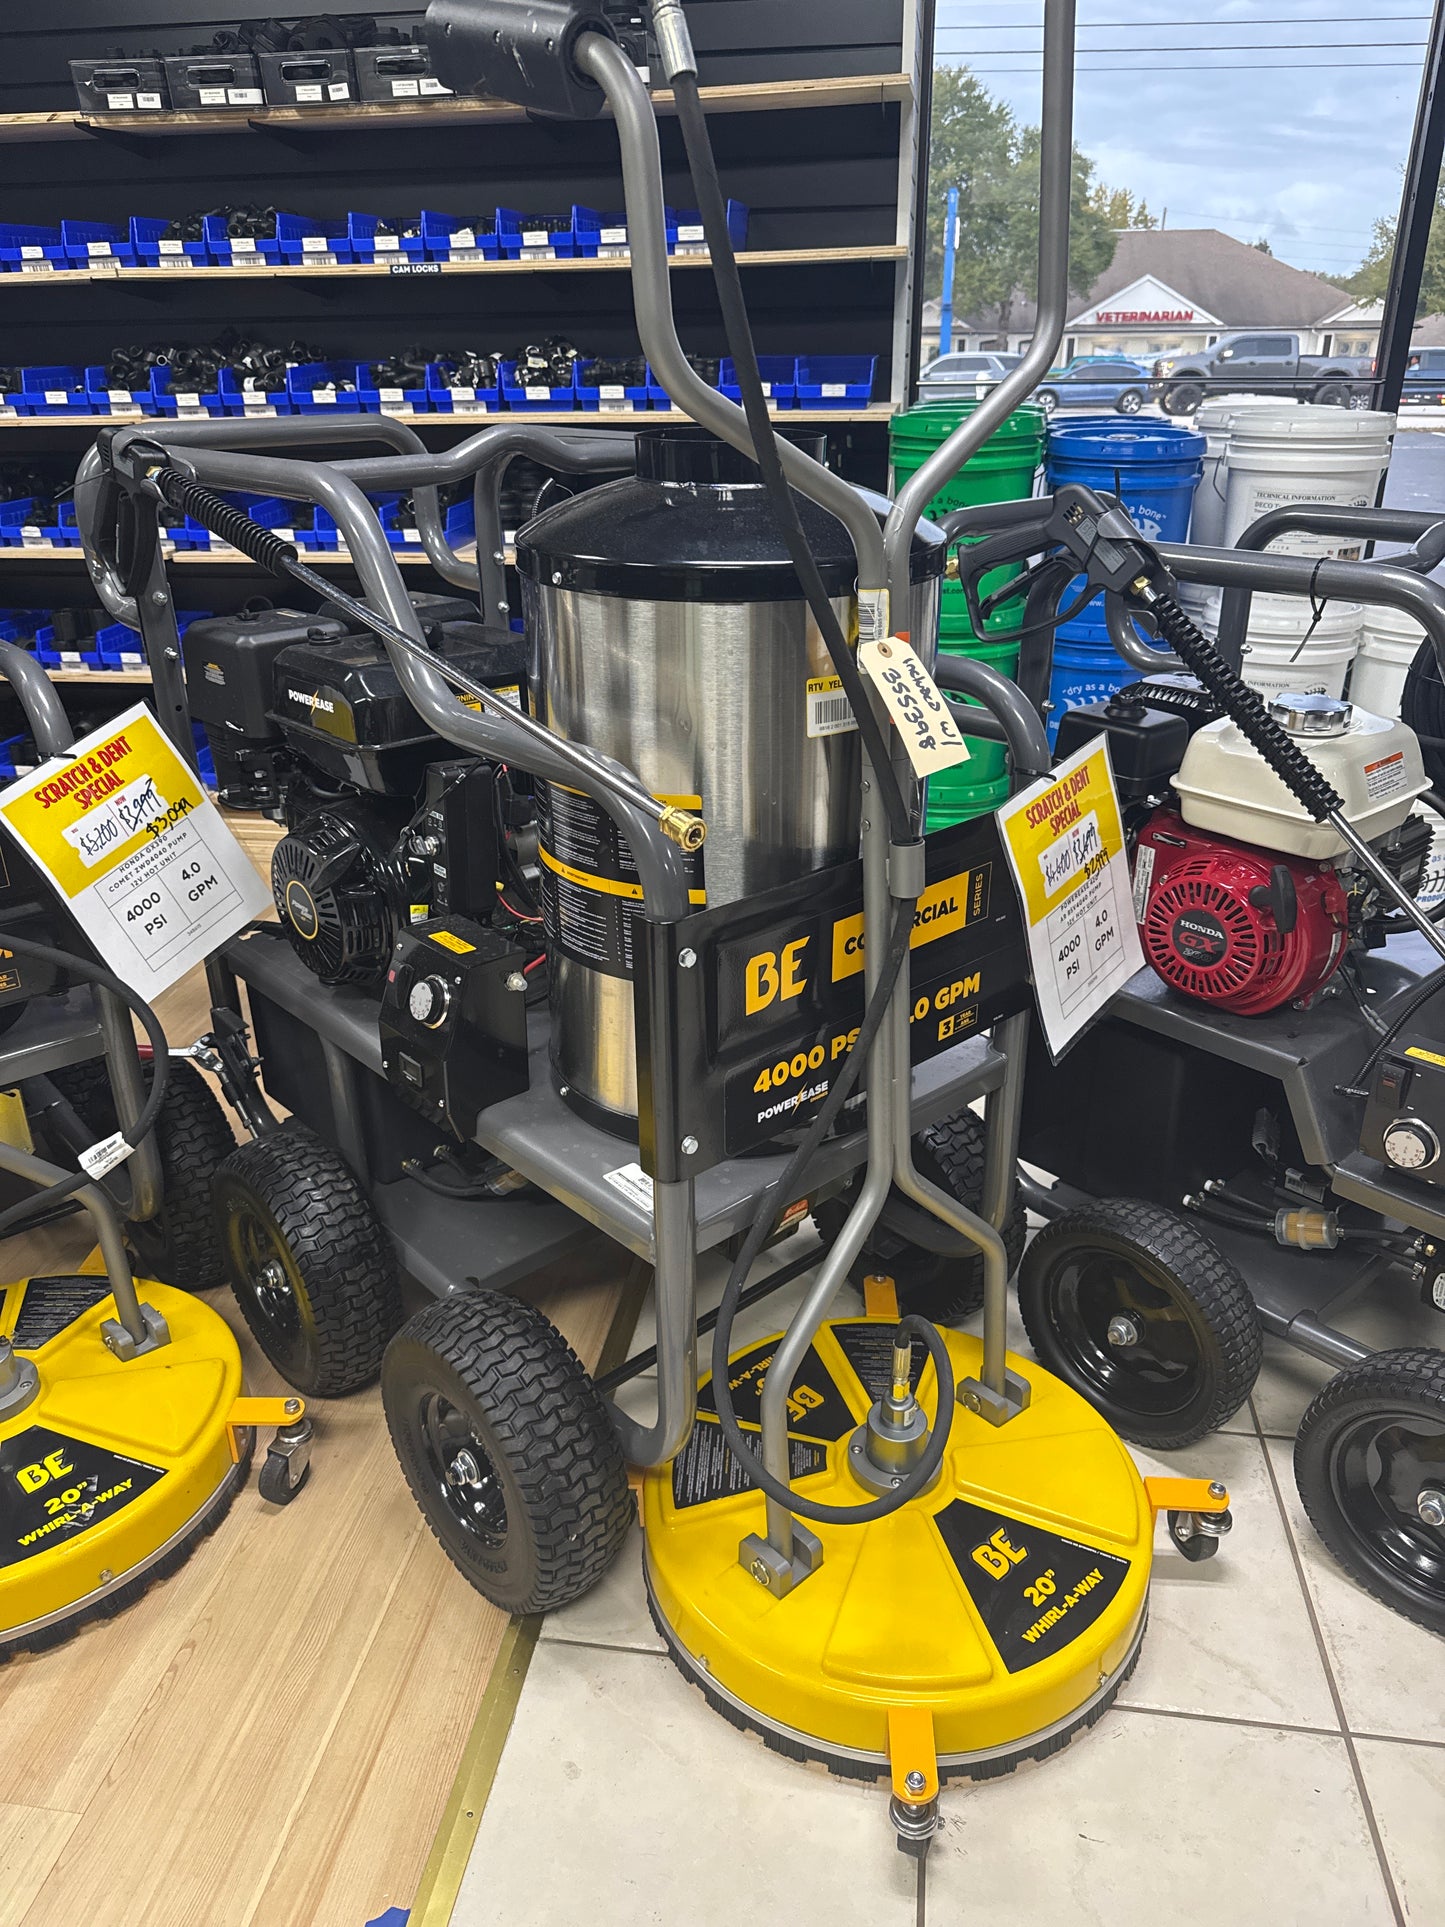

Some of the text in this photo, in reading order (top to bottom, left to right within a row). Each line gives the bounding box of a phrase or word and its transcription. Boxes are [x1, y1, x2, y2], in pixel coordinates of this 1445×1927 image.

[391, 264, 439, 274] CAM LOCKS
[1096, 310, 1194, 323] VETERINARIAN
[1256, 491, 1336, 502] TECHNICAL INFORMATION
[808, 682, 824, 692] RTV
[34, 735, 133, 809] SCRATCH & DENT
[73, 769, 125, 810] SPECIAL
[1025, 765, 1091, 829] SCRATCH & DENT
[145, 797, 194, 839] $3,099
[1049, 799, 1082, 837] SPECIAL
[108, 832, 188, 893] COMET ZWD4040 PUMP
[119, 835, 168, 873] HONDA GX390
[130, 851, 178, 888] 12V HOT UNIT
[181, 861, 201, 881] 4.0
[188, 874, 219, 902] GPM
[972, 872, 985, 917] SERIES
[1088, 881, 1102, 898] PUMP
[126, 891, 161, 922] 4000
[1095, 909, 1108, 928] 4.0
[144, 913, 168, 936] PSI
[1094, 926, 1115, 951] GPM
[1179, 919, 1225, 940] HONDA
[1058, 934, 1081, 963] 4000
[1178, 932, 1221, 954] GX
[744, 934, 811, 1017] BE
[1066, 958, 1080, 980] PSI
[753, 1043, 826, 1094] 4000
[908, 995, 930, 1025] .0
[934, 970, 981, 1010] GPM
[942, 1020, 951, 1036] 3
[15, 1447, 75, 1494] BE
[16, 1478, 133, 1546] WHIRL-A-WAY
[971, 1527, 1029, 1581] BE
[1021, 1568, 1104, 1644] WHIRL-A-WAY
